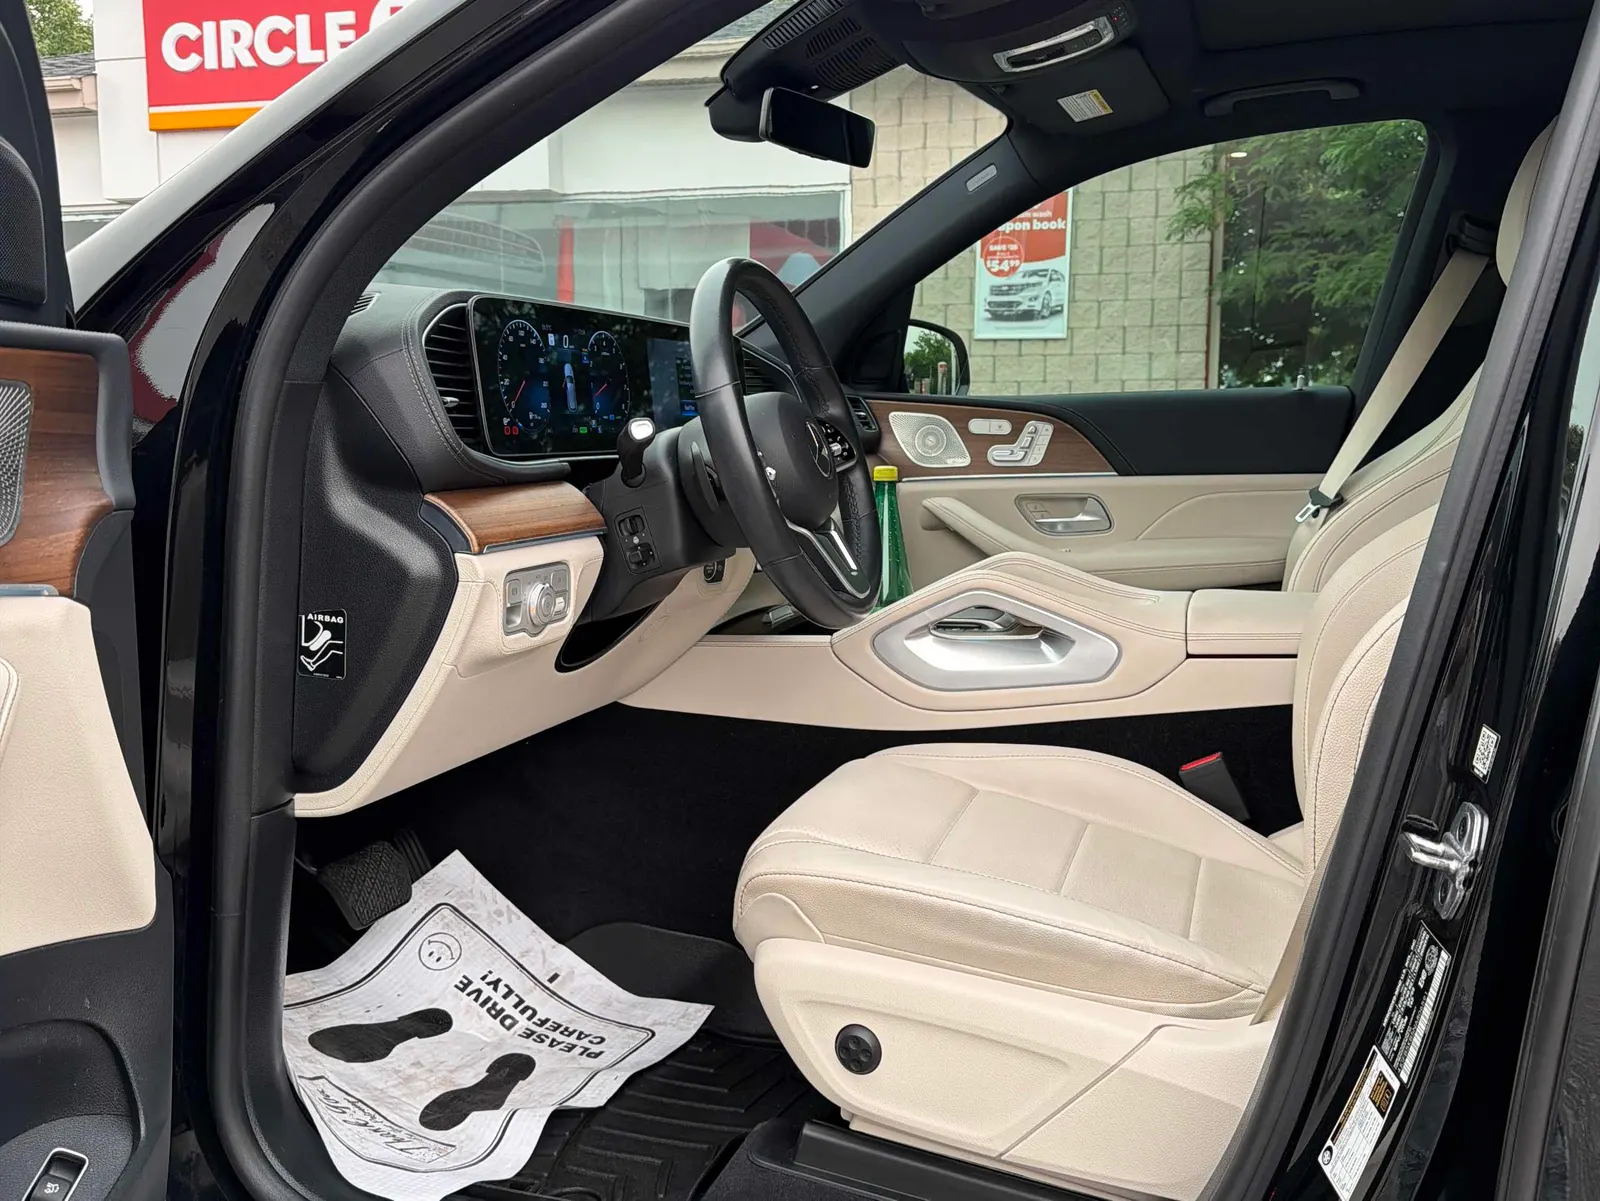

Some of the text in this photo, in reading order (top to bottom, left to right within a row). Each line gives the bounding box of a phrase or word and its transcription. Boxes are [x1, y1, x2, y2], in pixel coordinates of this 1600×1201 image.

[161, 11, 356, 72] CIRCLE
[997, 218, 1066, 234] upon book
[307, 613, 344, 624] AIRBAG
[453, 974, 605, 1059] PLEASE DRIVE
[480, 970, 606, 1045] CAREFULLY!
[342, 1118, 430, 1155] Thank
